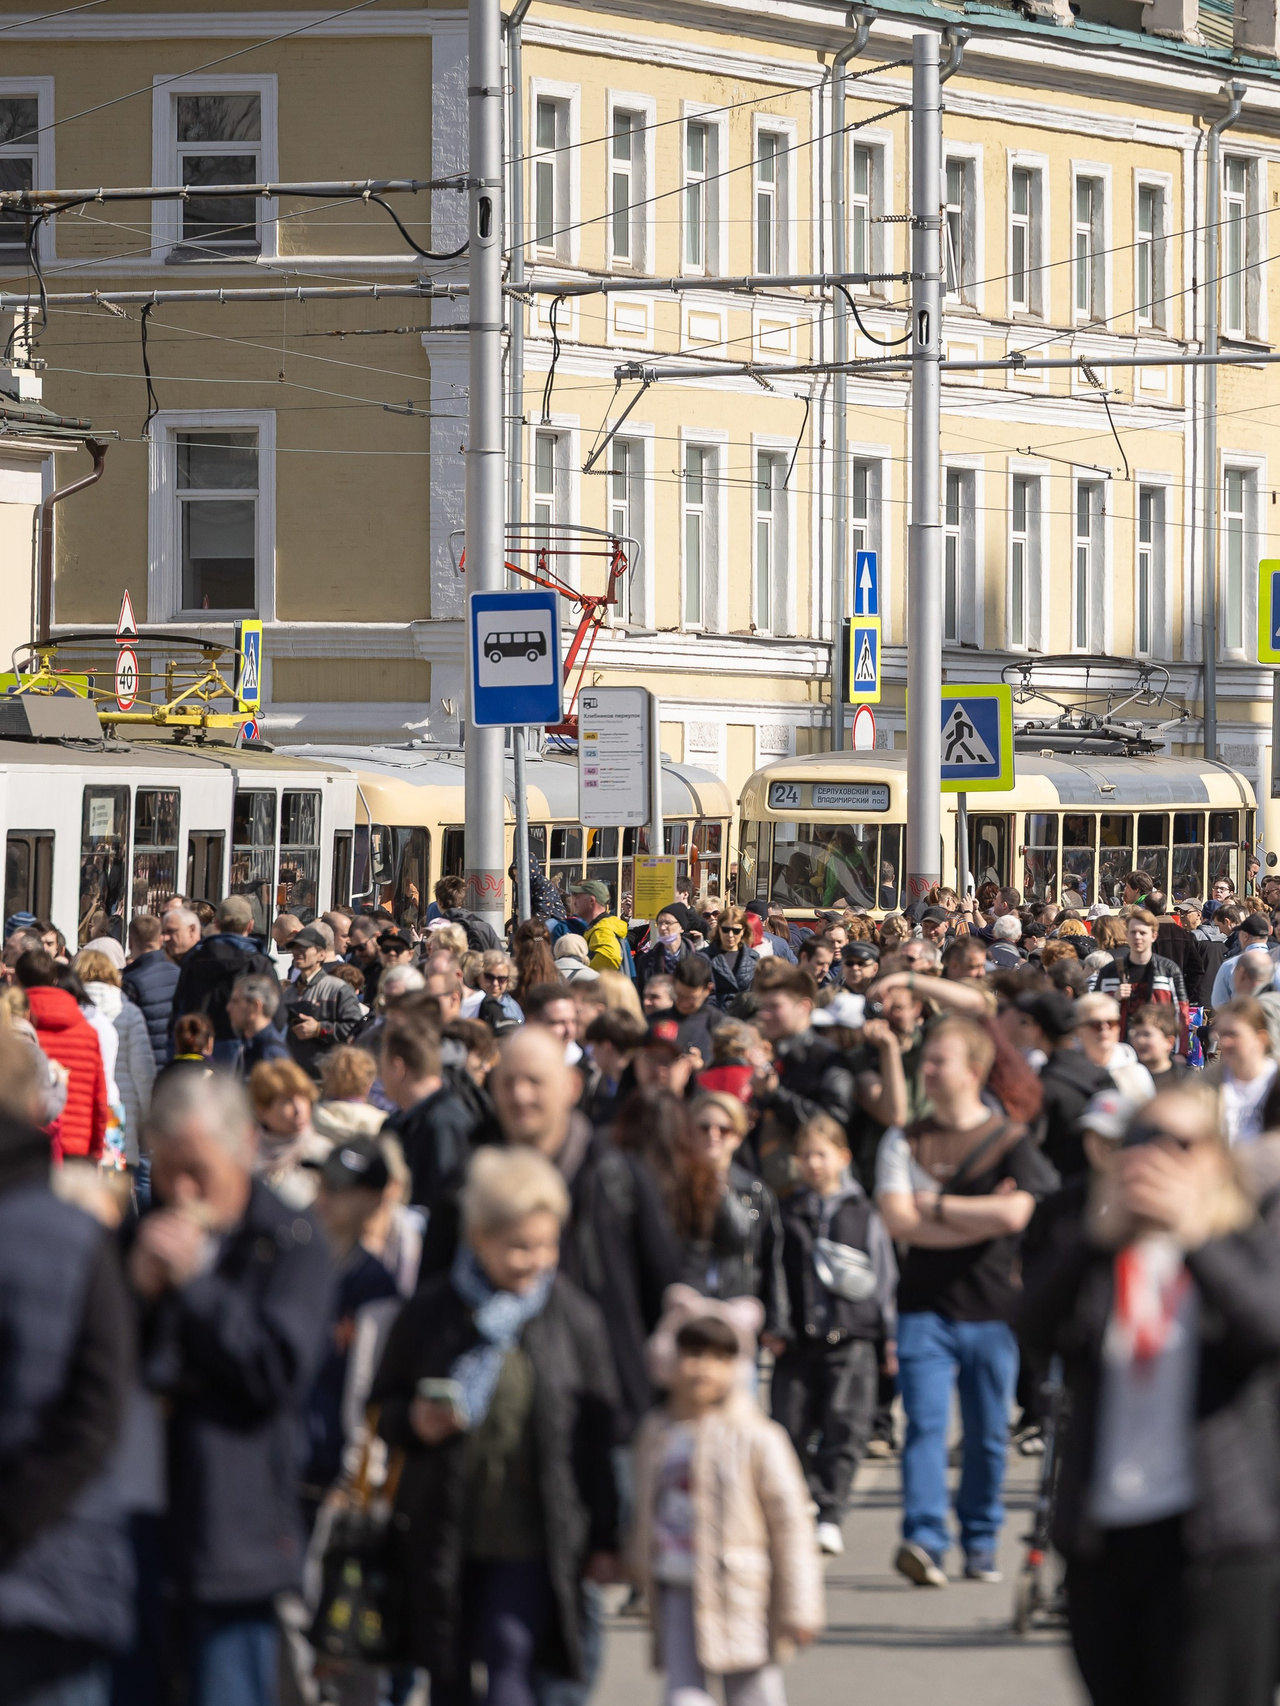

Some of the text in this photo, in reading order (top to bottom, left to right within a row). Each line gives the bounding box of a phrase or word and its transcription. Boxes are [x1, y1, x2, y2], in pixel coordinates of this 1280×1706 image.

[119, 665, 133, 690] 40
[775, 785, 799, 803] 24
[817, 787, 869, 795] СЕРПУХОВСКИЙ
